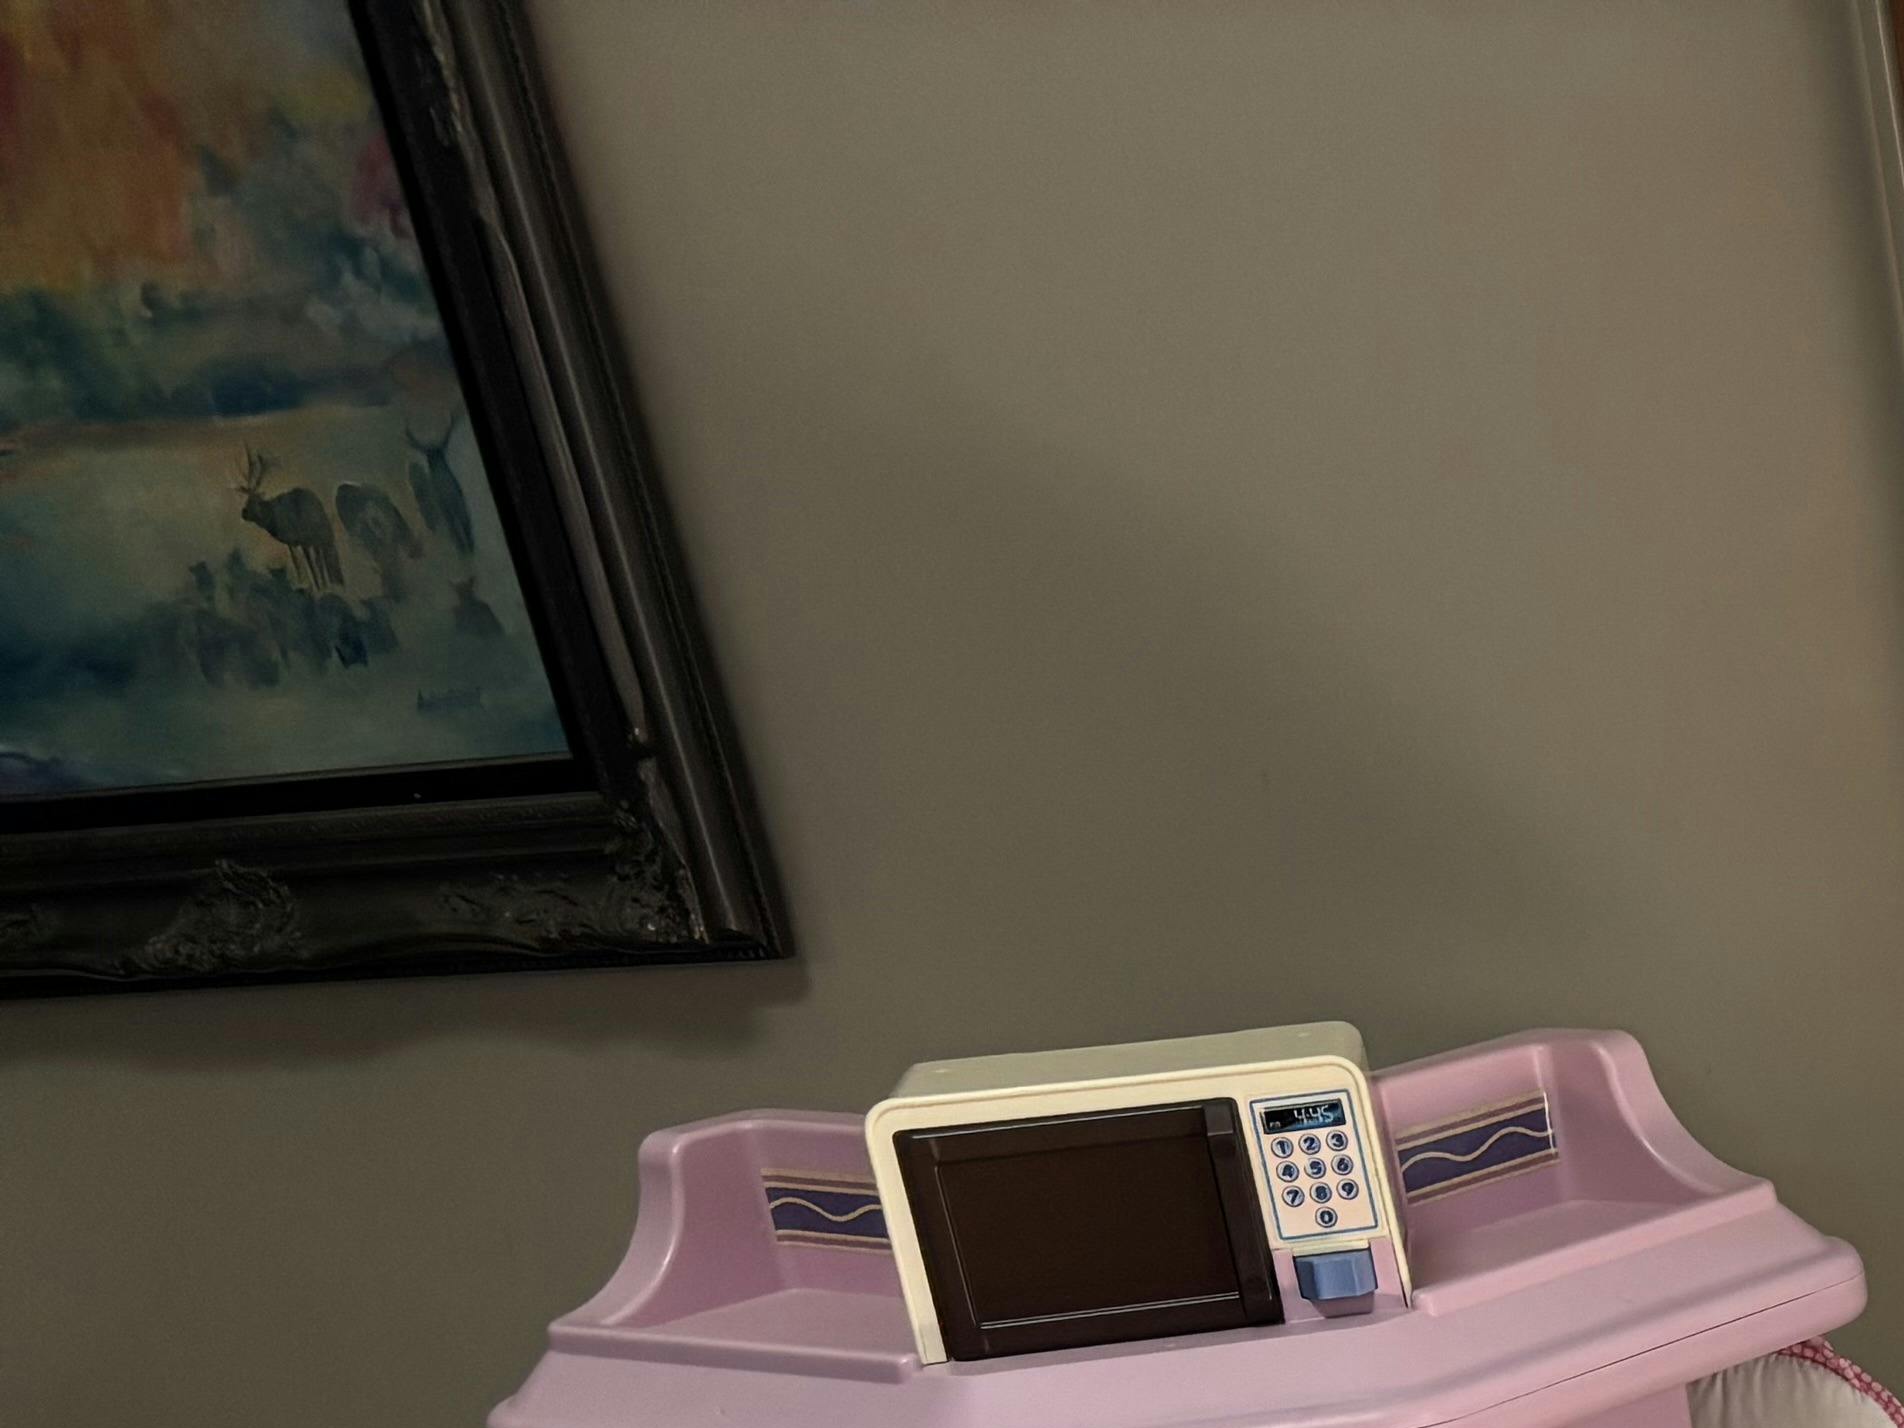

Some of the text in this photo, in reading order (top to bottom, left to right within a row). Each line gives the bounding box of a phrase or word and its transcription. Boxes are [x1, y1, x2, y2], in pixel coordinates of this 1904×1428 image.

[1303, 1136, 1316, 1151] 2
[1331, 1133, 1344, 1148] 3
[1309, 1160, 1322, 1175] 5
[1286, 1189, 1299, 1205] 7
[1315, 1185, 1327, 1200] 8
